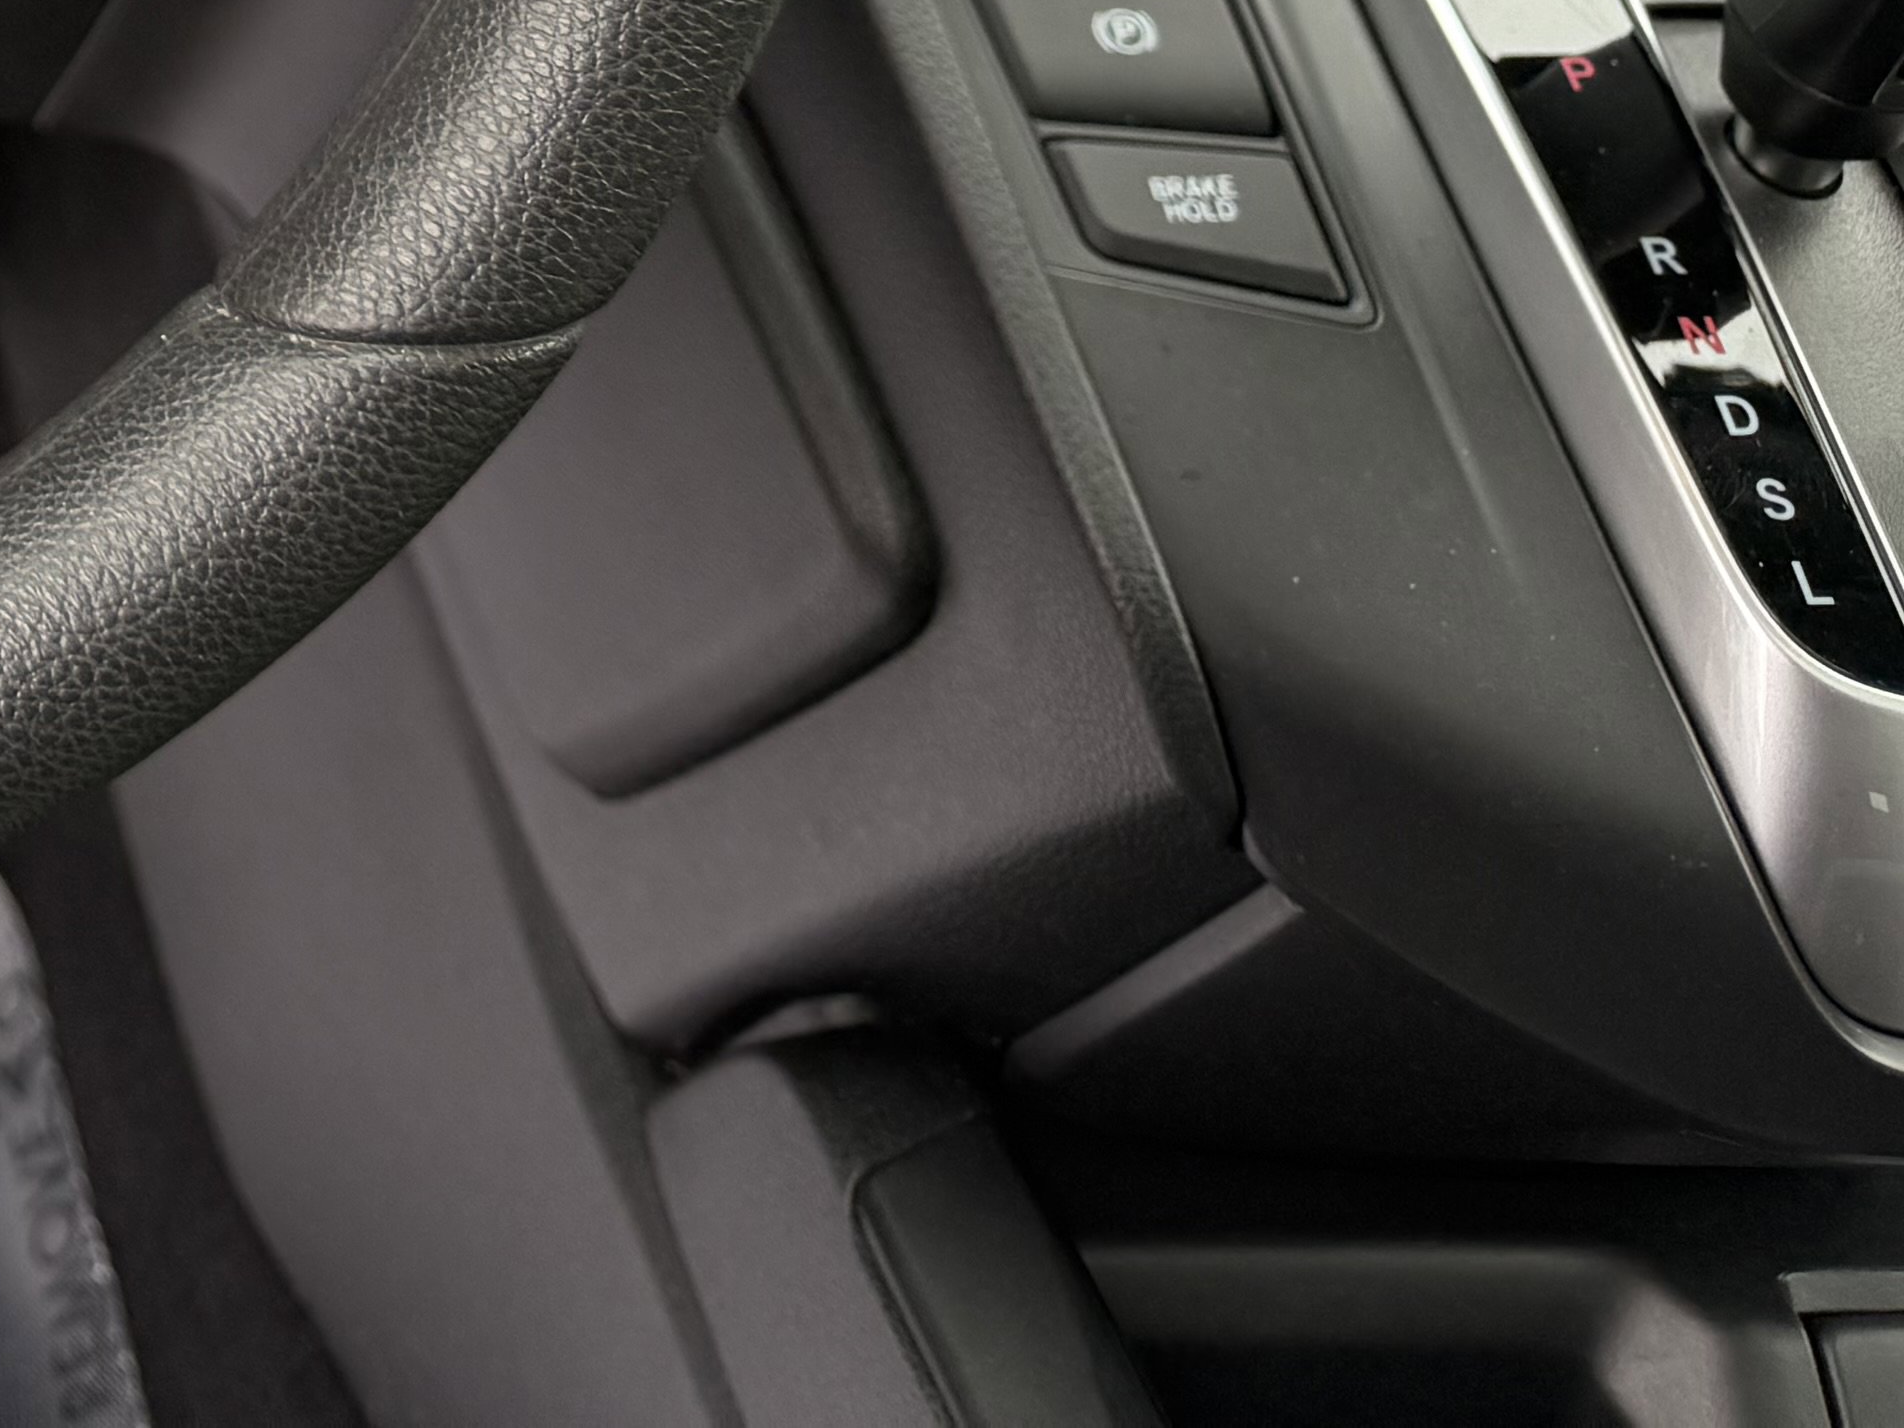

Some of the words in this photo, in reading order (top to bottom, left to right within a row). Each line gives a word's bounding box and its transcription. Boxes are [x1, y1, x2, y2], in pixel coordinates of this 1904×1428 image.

[1560, 57, 1596, 92] P
[1148, 175, 1240, 204] BRAKE
[1160, 197, 1239, 224] HOLD
[1640, 236, 1688, 276] R
[1677, 316, 1726, 355] N
[1714, 395, 1760, 437] D
[1755, 478, 1796, 521] S
[1792, 560, 1835, 606] L
